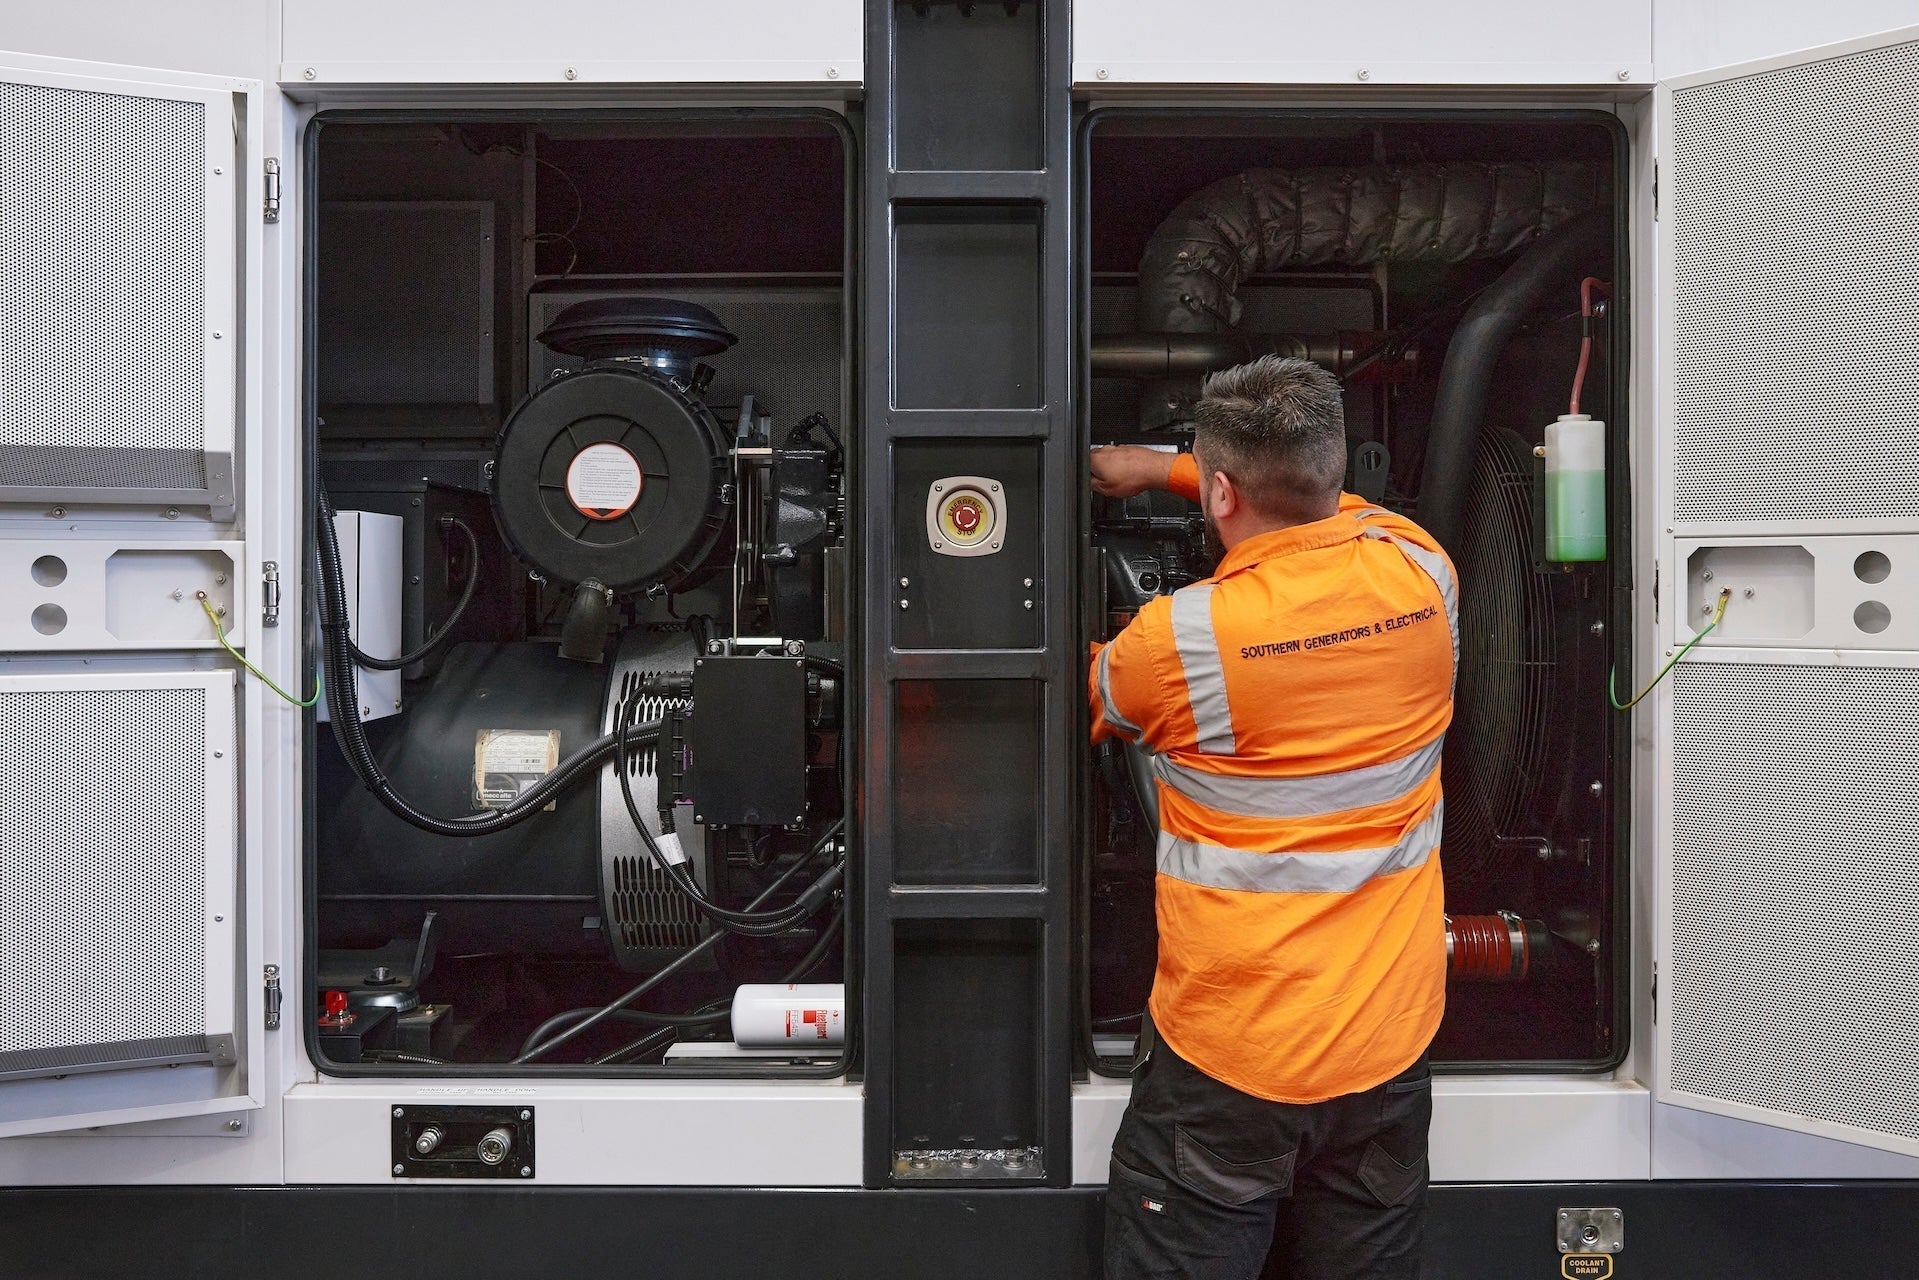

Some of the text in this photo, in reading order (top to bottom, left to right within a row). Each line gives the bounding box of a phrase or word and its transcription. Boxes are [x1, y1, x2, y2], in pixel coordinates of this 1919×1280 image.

[948, 498, 984, 517] EMERGENCY
[957, 527, 977, 536] STOP
[1241, 605, 1438, 659] SOUTHERN GENERATORS & ELECTRICAL
[791, 1010, 799, 1037] FF5457
[815, 1009, 828, 1040] Fleetguard
[1569, 1259, 1605, 1267] COOLANT
